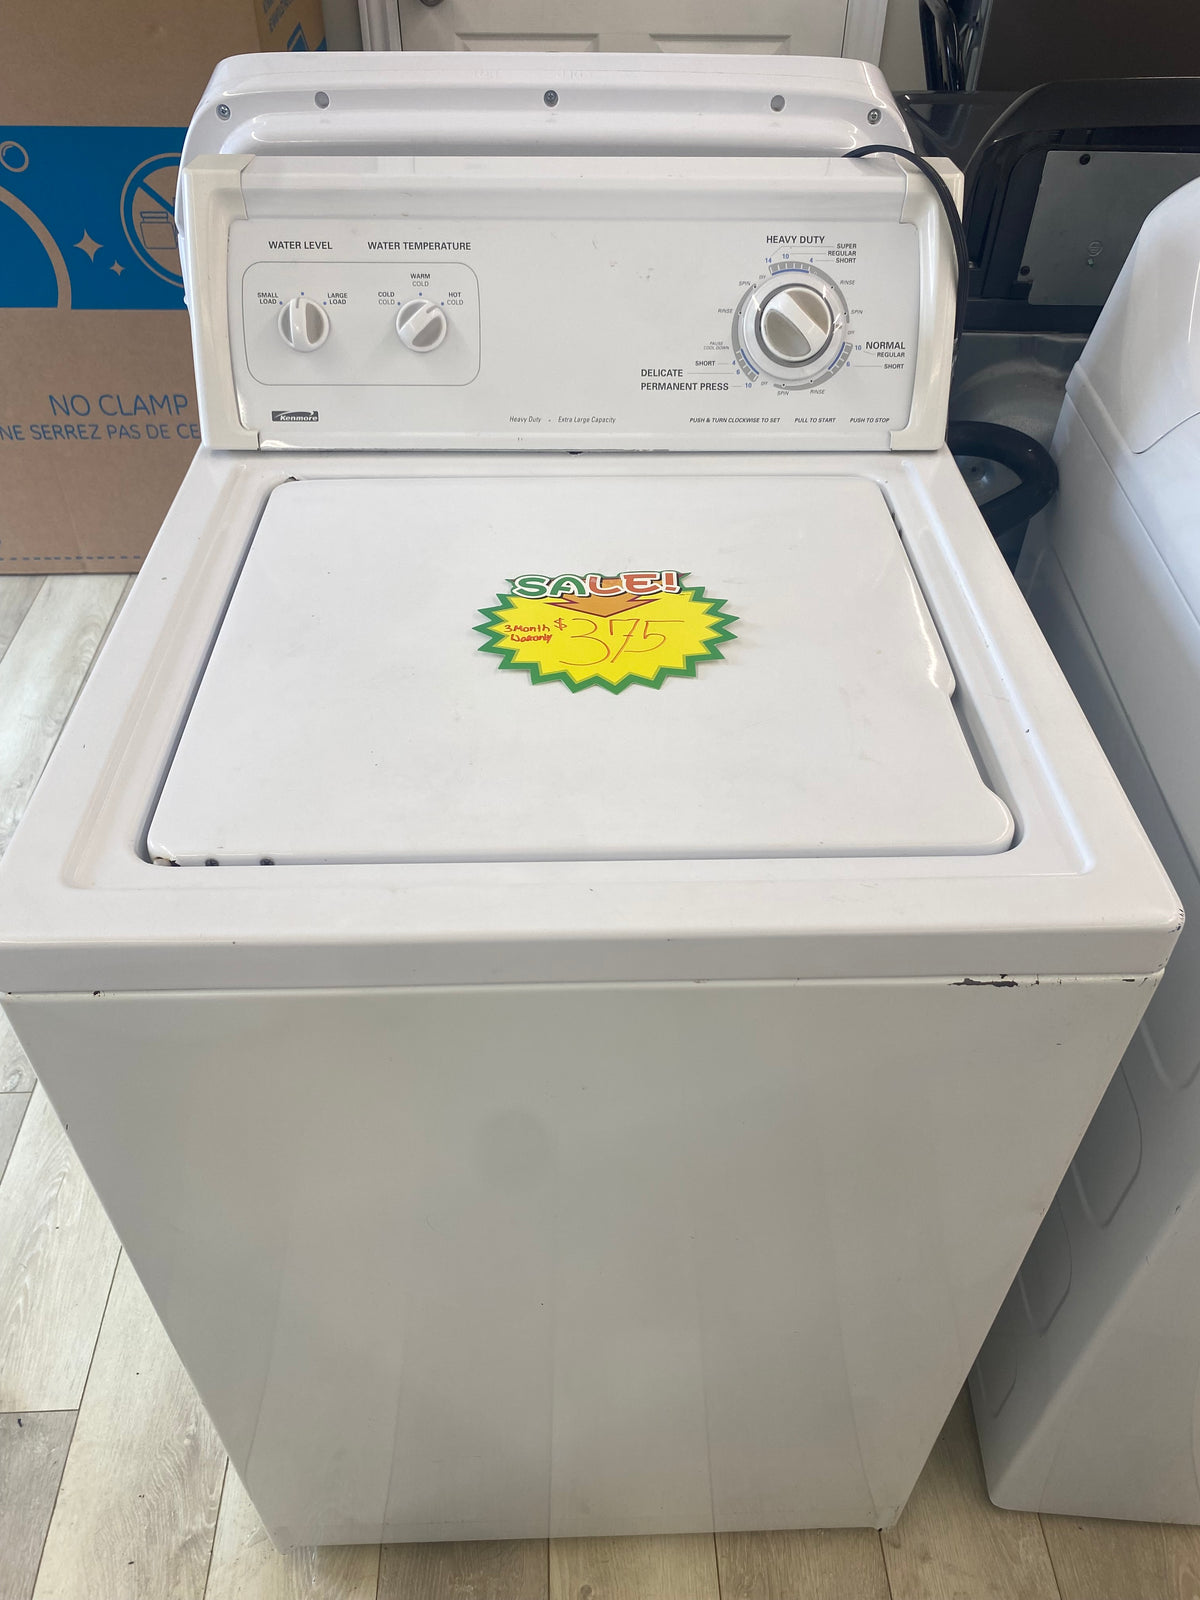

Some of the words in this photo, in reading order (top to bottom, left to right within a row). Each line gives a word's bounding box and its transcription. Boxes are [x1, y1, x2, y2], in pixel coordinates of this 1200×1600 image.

[766, 235, 797, 244] HEAVY
[799, 235, 825, 244] DUTY
[268, 241, 302, 250] WATER
[304, 241, 333, 250] LEVEL
[367, 241, 401, 251] WATER
[402, 241, 472, 251] TEMPERATURE
[865, 341, 906, 350] NORMAL
[640, 368, 684, 377] DELICATE
[640, 382, 698, 391] PERMANENT
[700, 382, 729, 391] PRESS
[49, 394, 91, 417] NO
[98, 394, 188, 416] CLAMP
[279, 413, 318, 422] Kenmore
[509, 415, 528, 424] Heavy
[528, 415, 542, 424] Duty
[558, 415, 573, 423] Extra
[573, 415, 590, 424] Large
[591, 415, 616, 424] Capacity
[0, 424, 26, 441] NE
[30, 424, 102, 440] SERREZ
[106, 423, 141, 440] PAS
[145, 423, 171, 440] DE
[176, 423, 200, 439] CE
[511, 571, 682, 599] SALE!
[513, 624, 551, 633] Month
